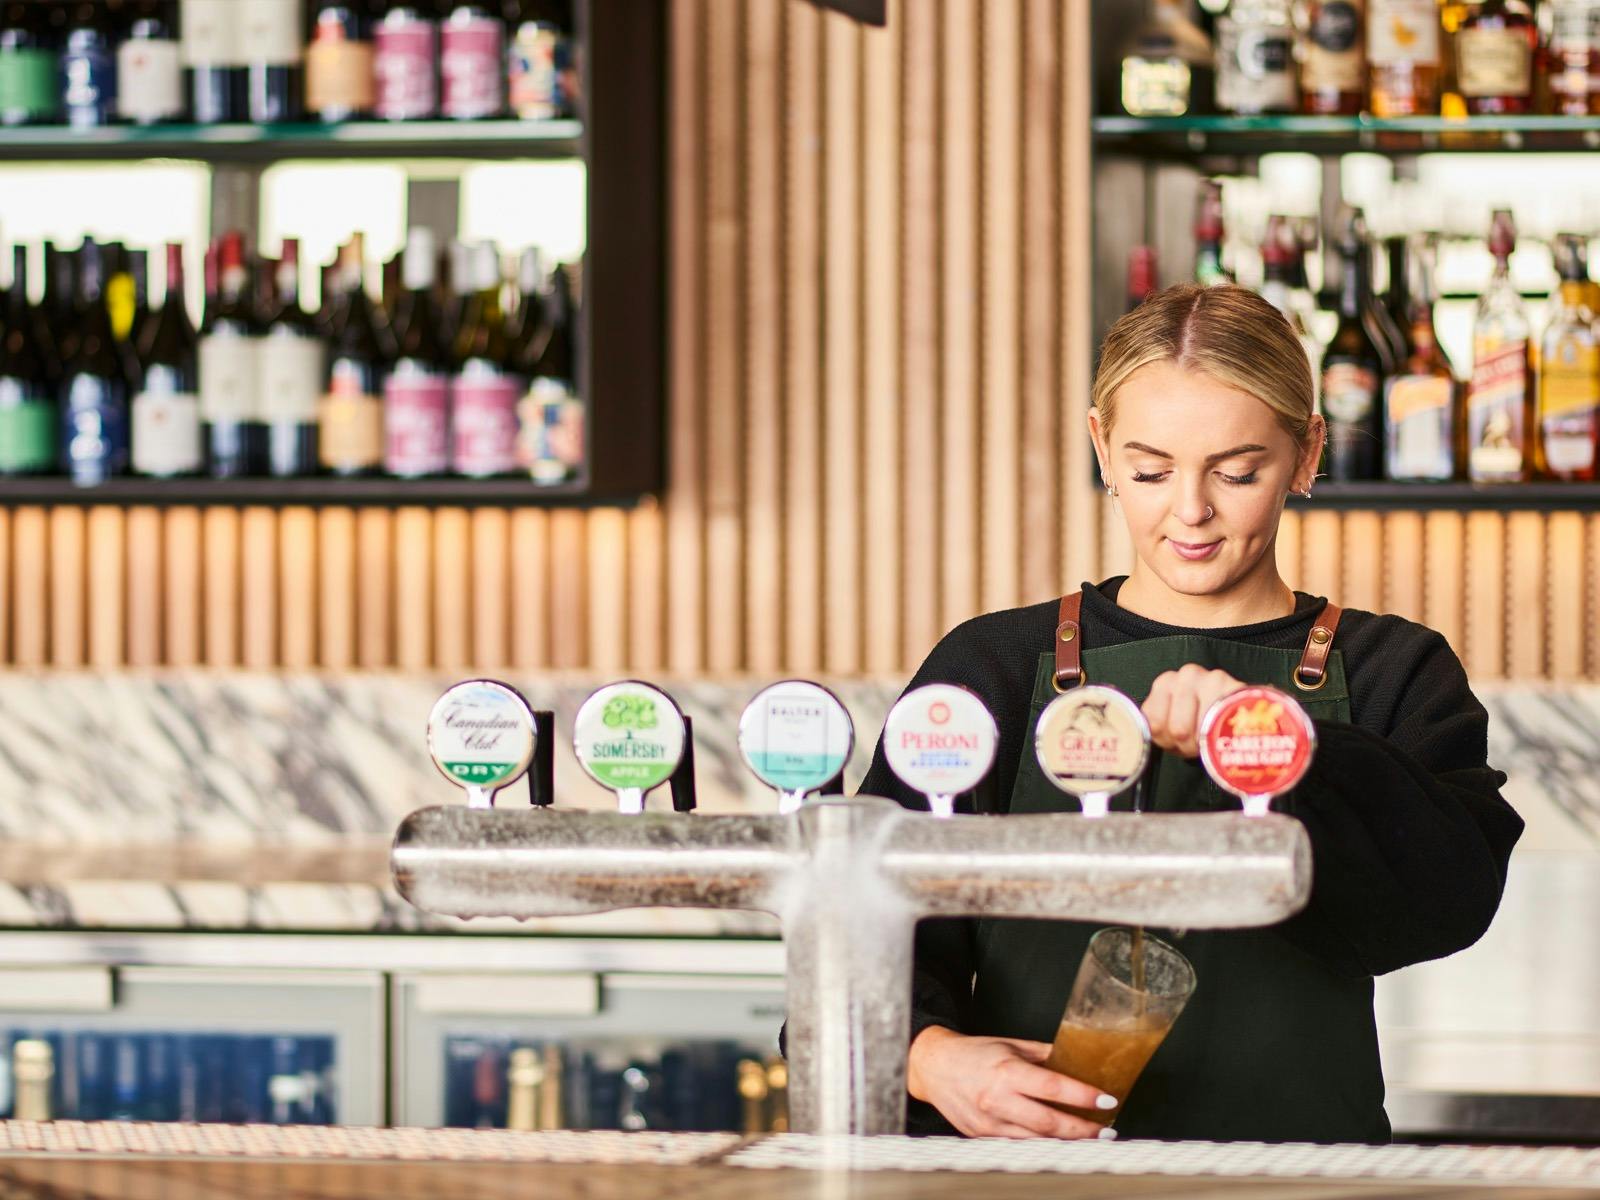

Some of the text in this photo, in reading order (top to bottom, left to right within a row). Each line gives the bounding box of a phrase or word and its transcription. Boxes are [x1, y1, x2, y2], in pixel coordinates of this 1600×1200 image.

[442, 707, 518, 729] Canadian
[461, 730, 501, 750] Club
[901, 731, 978, 750] PERONI
[1059, 736, 1119, 752] GREAT
[593, 743, 665, 758] SOMERSBY
[452, 764, 505, 776] DRY
[610, 766, 650, 777] APPLE
